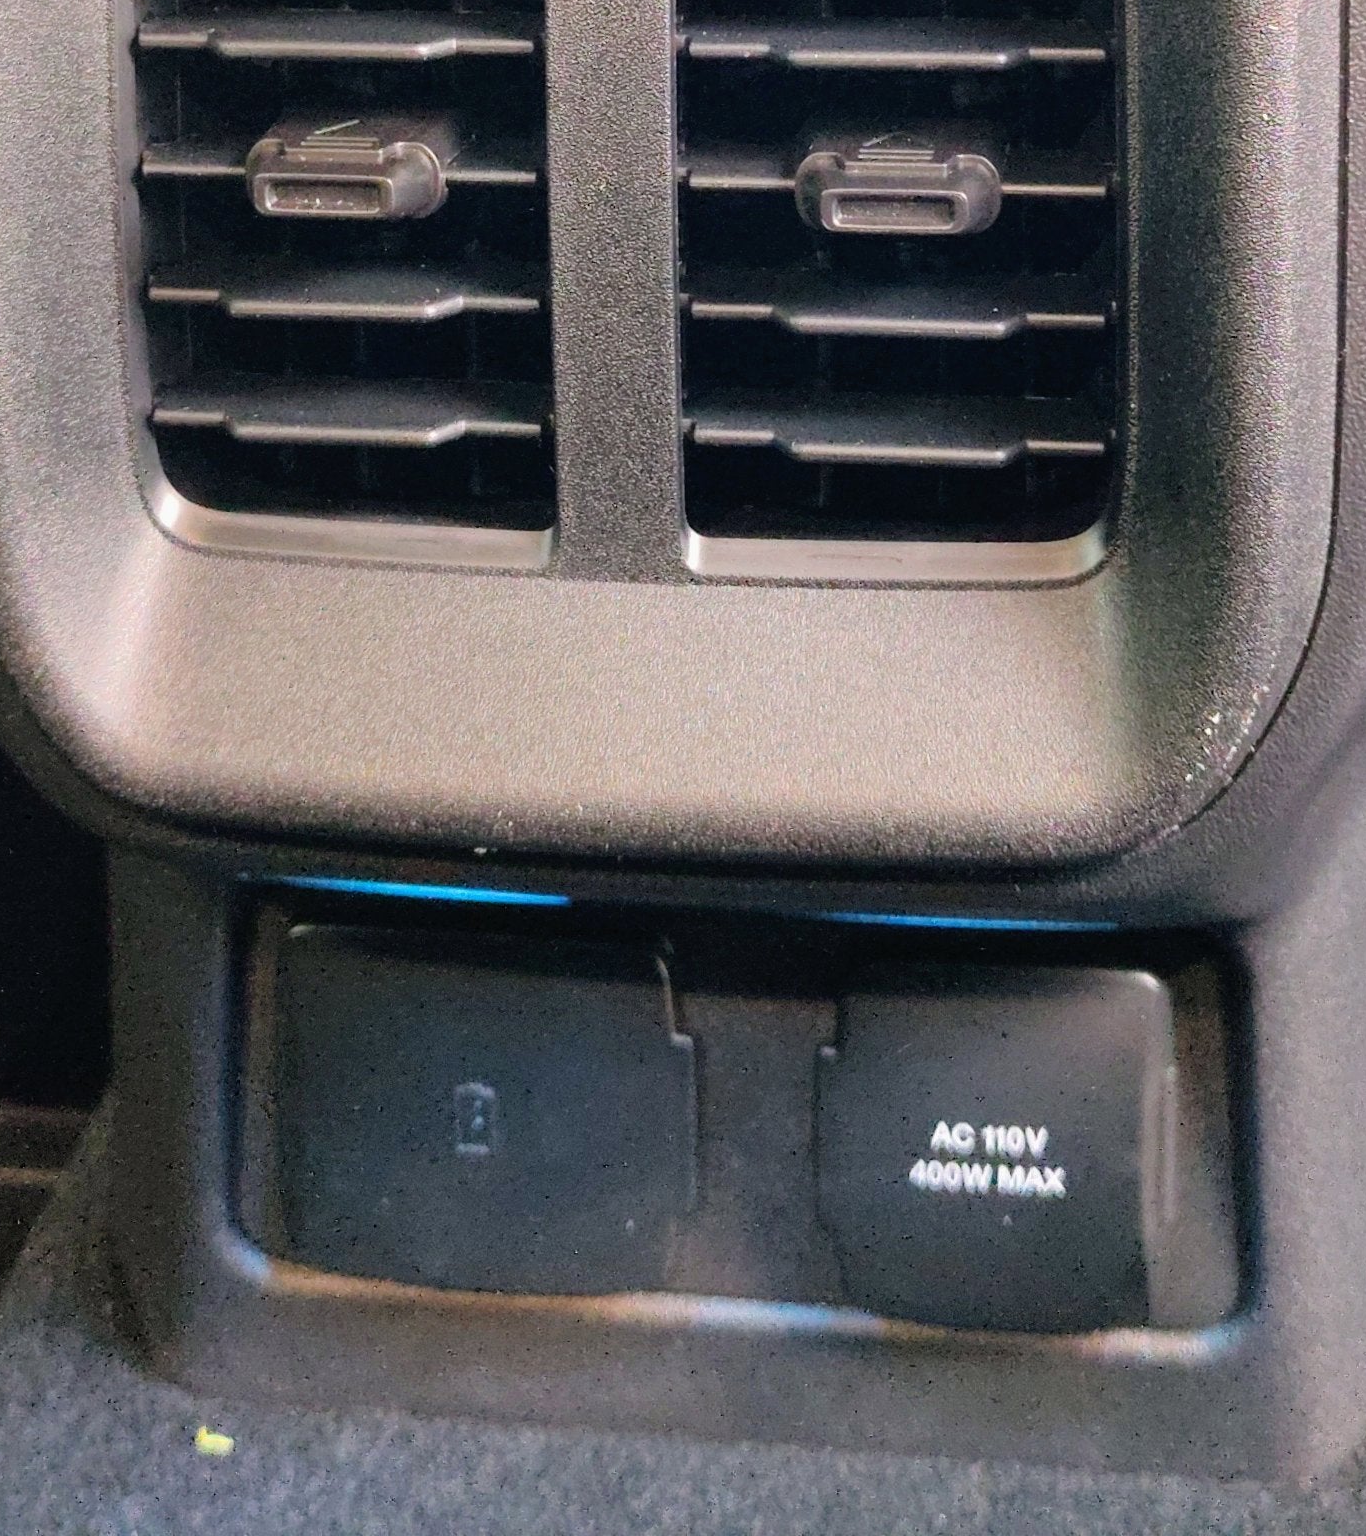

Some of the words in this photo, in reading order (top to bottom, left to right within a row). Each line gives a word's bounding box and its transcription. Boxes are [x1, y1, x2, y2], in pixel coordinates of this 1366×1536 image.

[930, 1120, 976, 1157] AC
[981, 1124, 1049, 1159] 110V
[908, 1158, 994, 1194] 400W
[996, 1163, 1067, 1199] MAX
